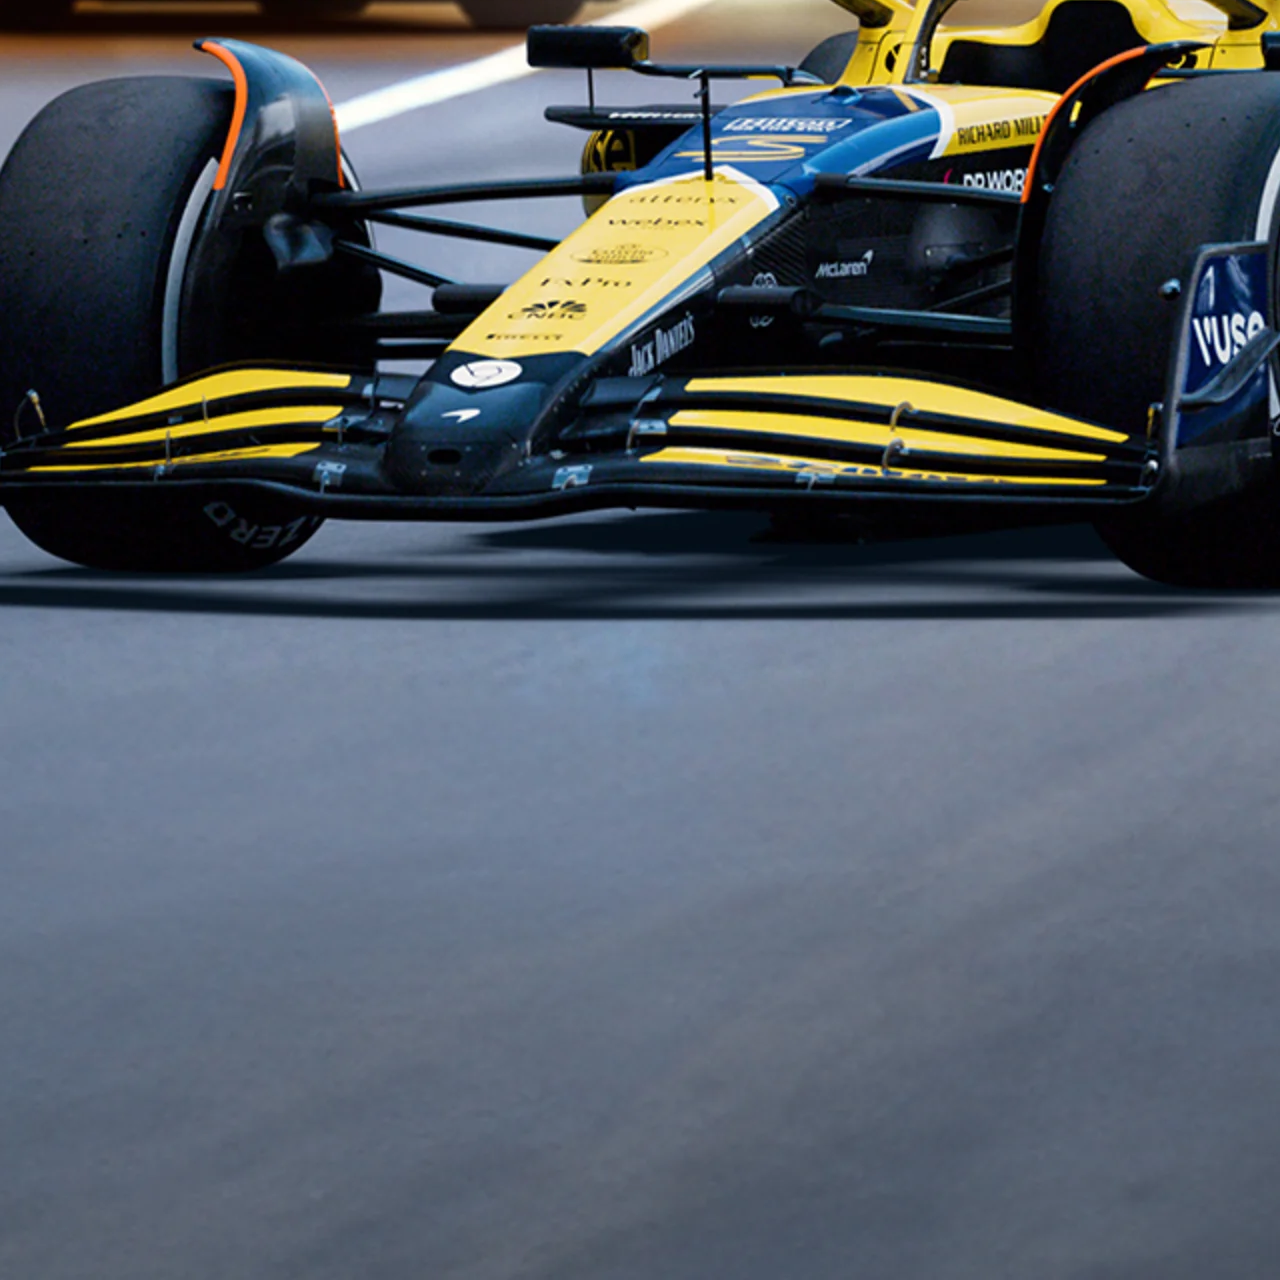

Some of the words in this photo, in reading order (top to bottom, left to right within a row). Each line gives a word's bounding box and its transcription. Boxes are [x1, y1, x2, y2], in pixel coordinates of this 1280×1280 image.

[957, 120, 1011, 146] RICHARD
[815, 260, 868, 279] McLaren
[628, 344, 655, 377] JACK
[203, 501, 307, 549] ZERO
